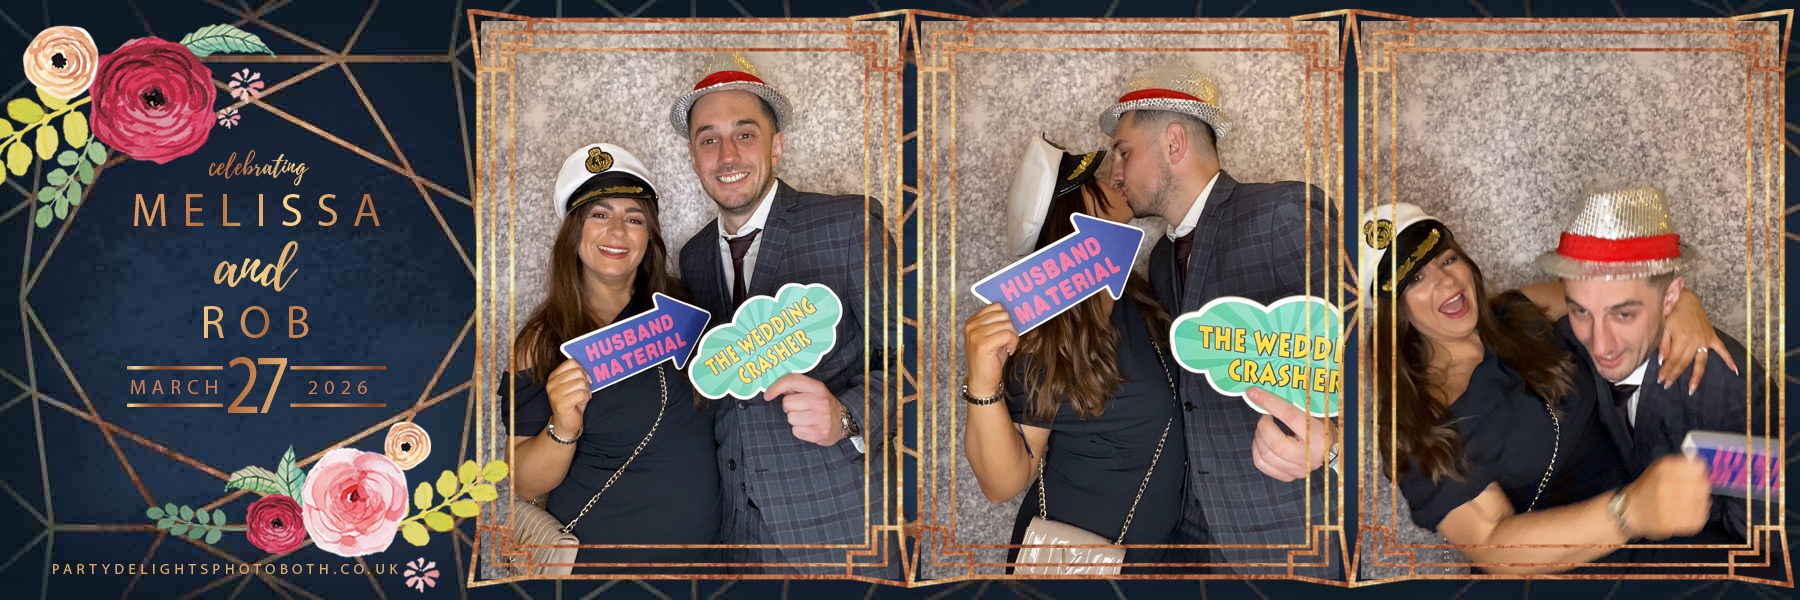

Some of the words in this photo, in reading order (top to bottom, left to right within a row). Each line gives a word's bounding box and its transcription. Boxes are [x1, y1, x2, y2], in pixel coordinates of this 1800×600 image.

[1000, 236, 1101, 302] HUSBAND
[1013, 256, 1121, 325] MATERIAL
[585, 313, 675, 362] HUSBAND
[592, 332, 688, 383] MATERIAL
[705, 345, 741, 377] THE
[736, 296, 818, 355] WEDDING
[737, 329, 813, 384] CRASHER
[1199, 325, 1247, 354] THE
